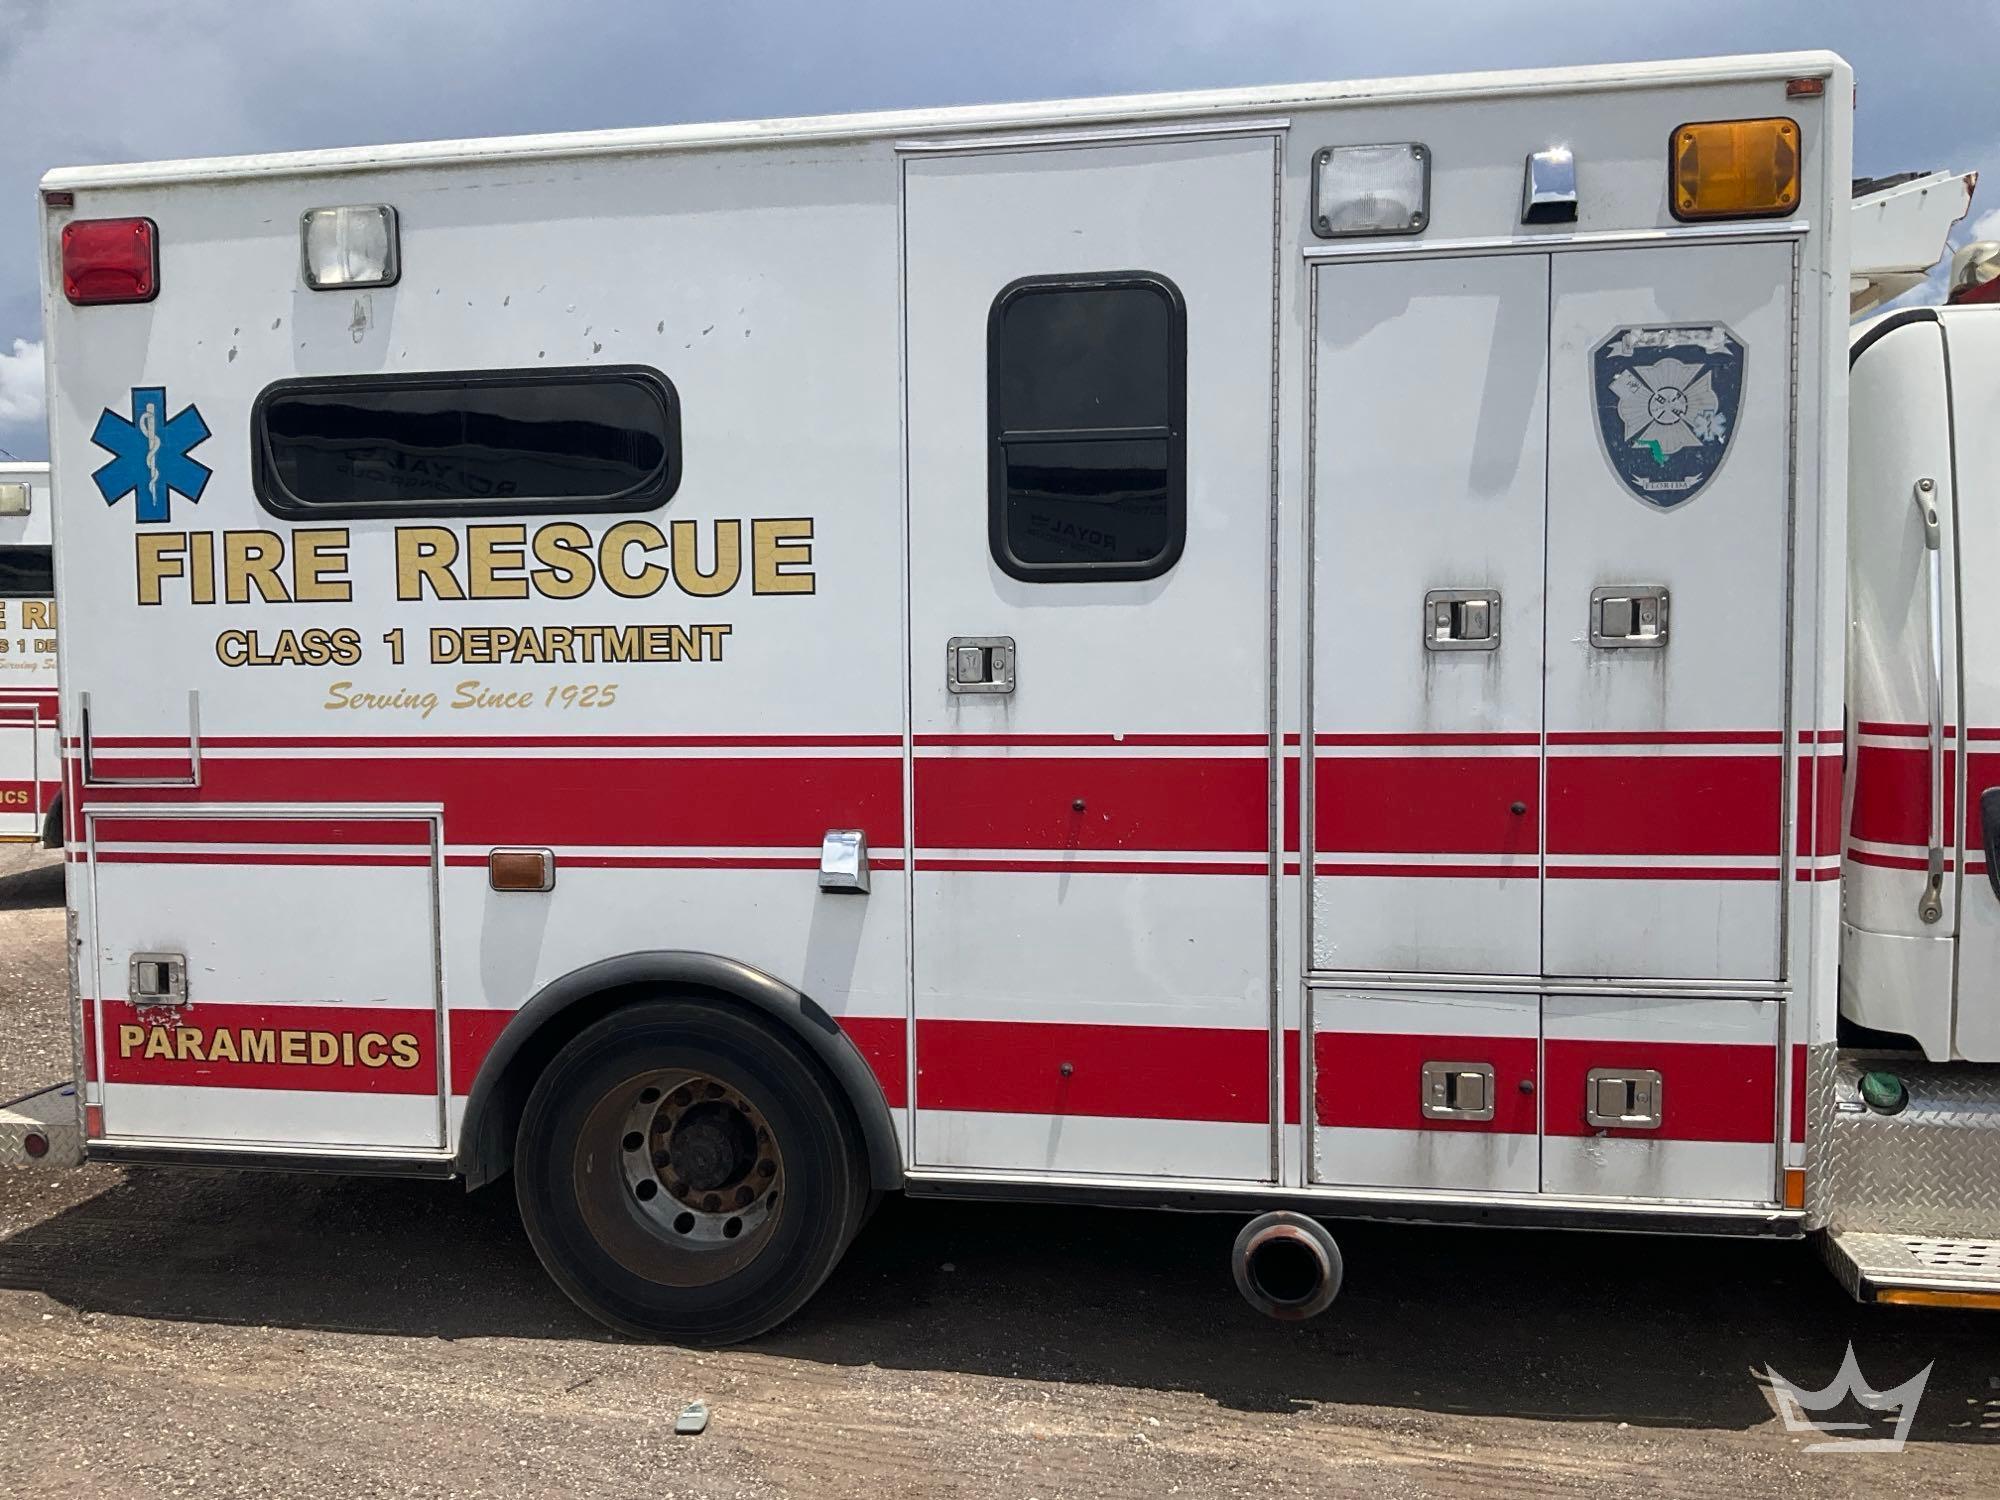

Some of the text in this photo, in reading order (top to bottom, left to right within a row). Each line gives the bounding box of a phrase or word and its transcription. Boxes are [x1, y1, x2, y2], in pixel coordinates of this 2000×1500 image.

[135, 517, 816, 606] FIRE RESCUE
[17, 639, 26, 653] 1
[216, 624, 732, 667] CLASS 1 DEPARTMENT
[324, 680, 619, 719] Serving Since 1925
[118, 1023, 421, 1070] PARAMEDICS
